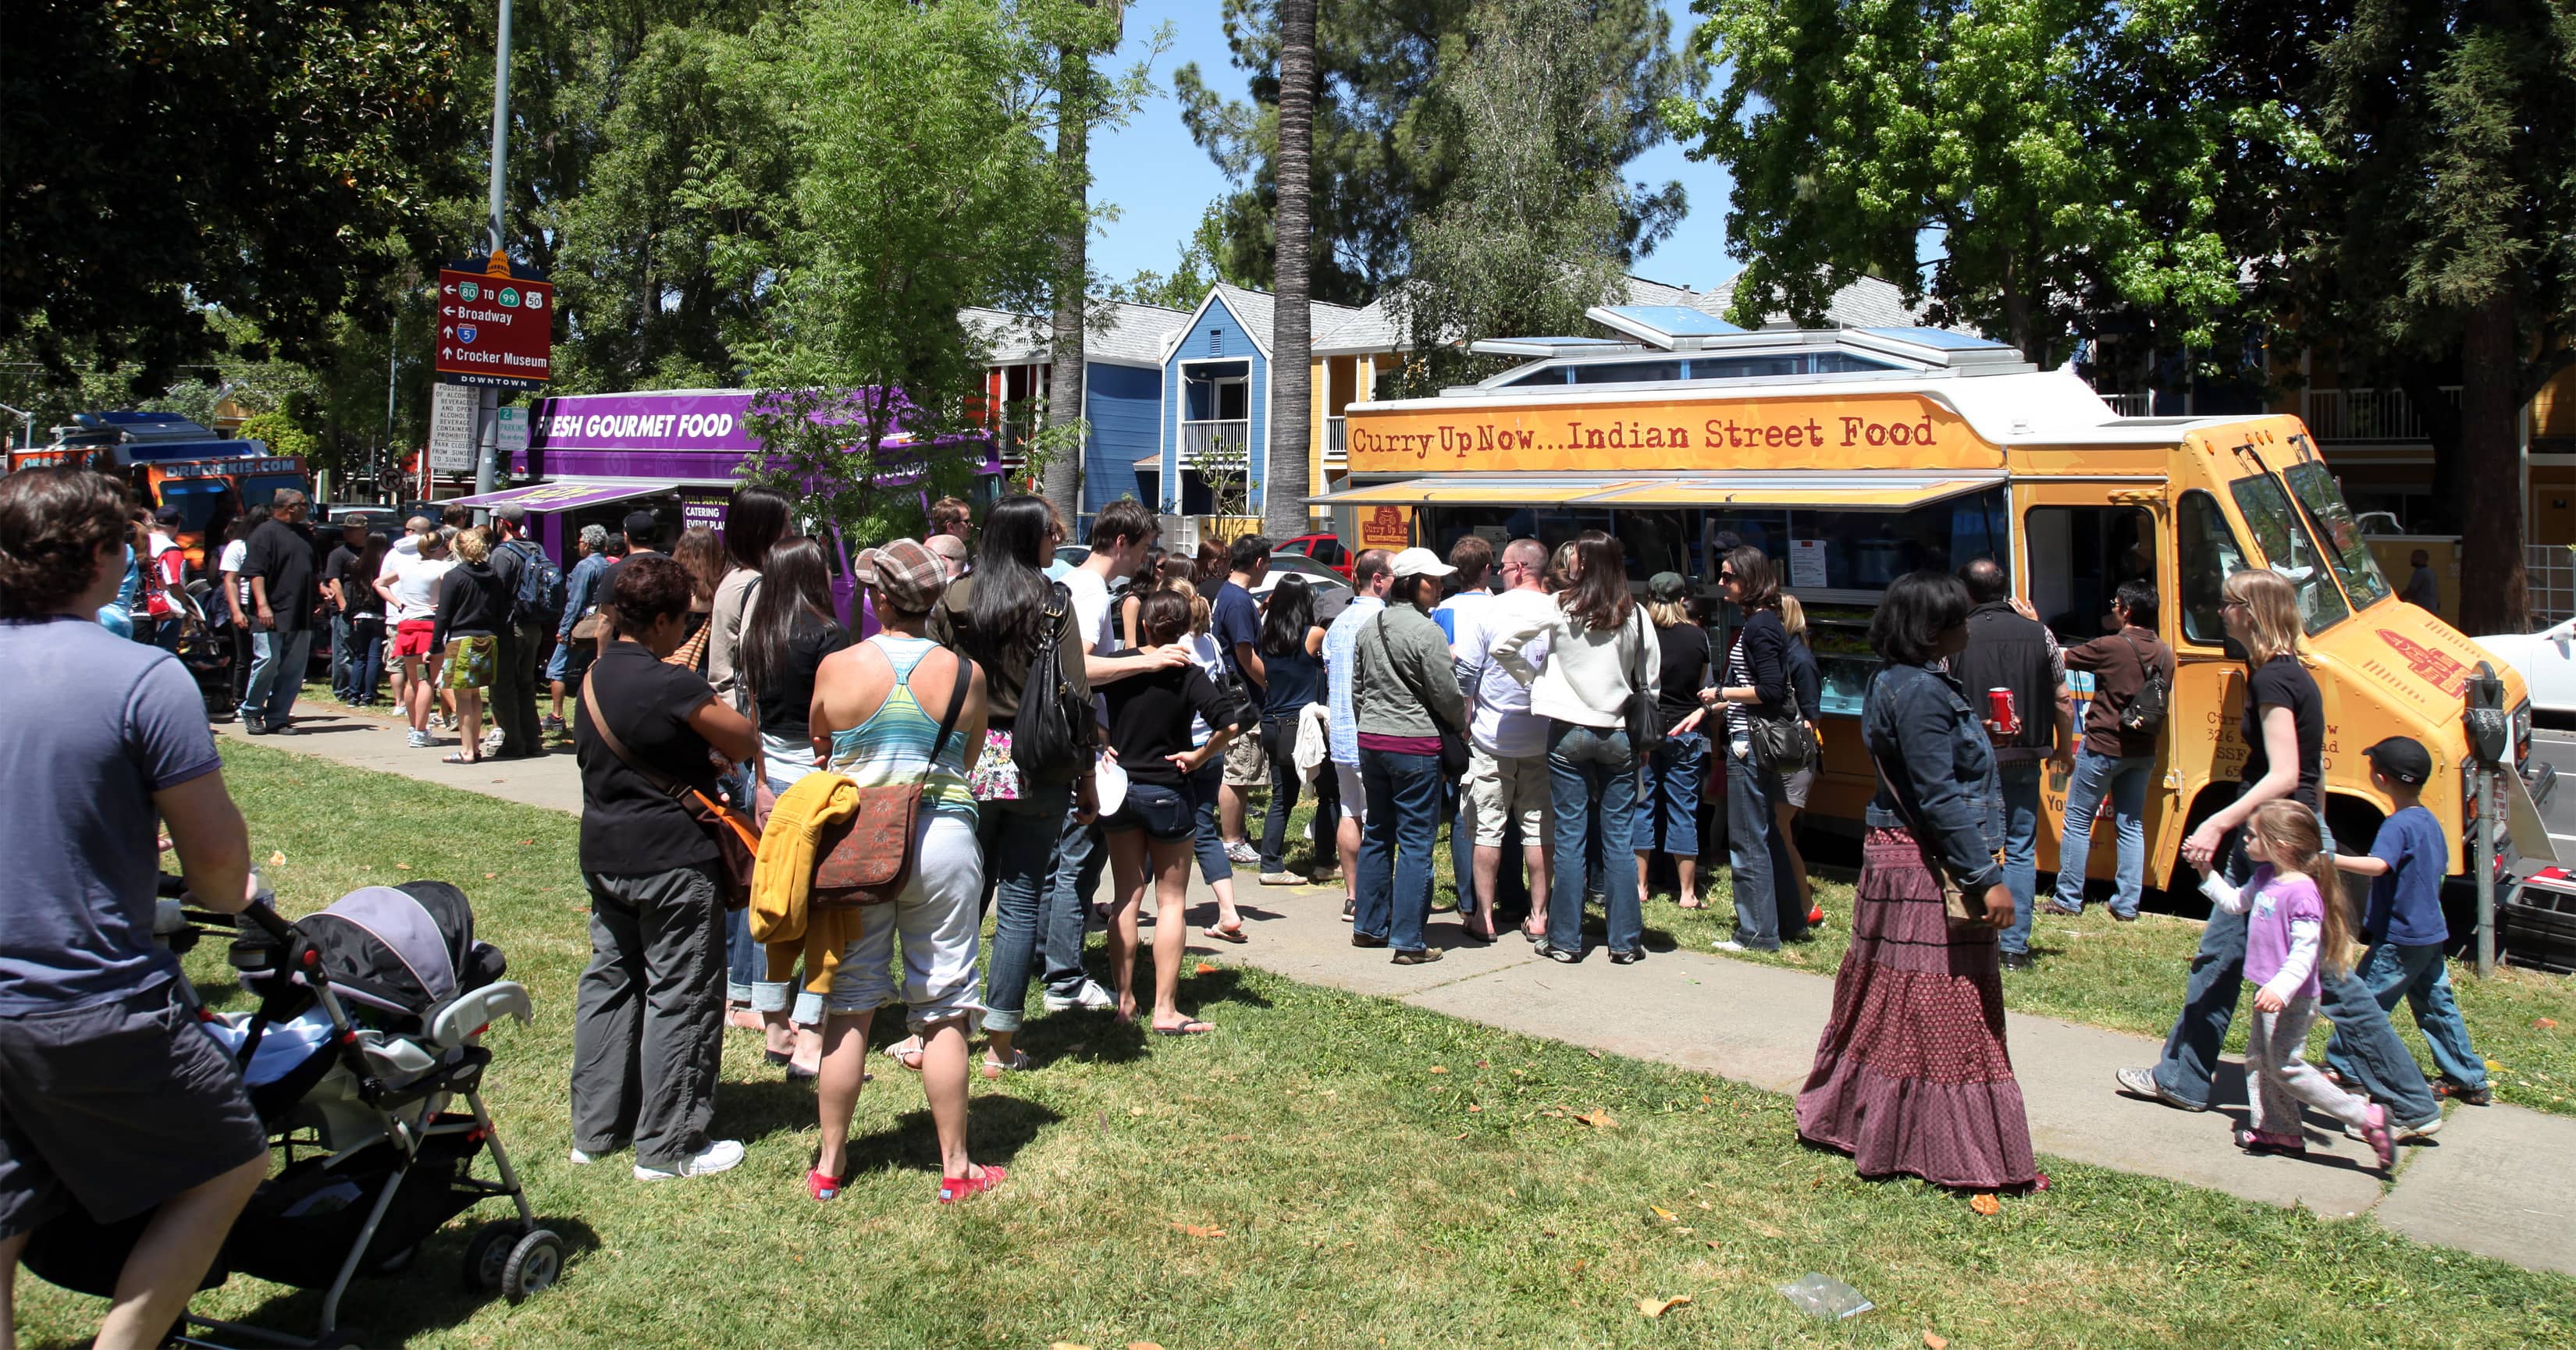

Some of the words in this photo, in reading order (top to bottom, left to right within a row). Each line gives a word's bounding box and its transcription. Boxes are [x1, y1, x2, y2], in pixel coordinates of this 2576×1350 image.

[462, 288, 475, 298] 80
[483, 289, 494, 300] TO
[503, 293, 515, 304] 99
[528, 297, 540, 307] 50
[457, 306, 513, 326] Broadway
[464, 330, 471, 339] 5
[456, 347, 501, 364] Crocker
[503, 352, 547, 368] Museum
[461, 375, 527, 387] DOWNTOWN
[503, 410, 510, 419] 2
[534, 415, 584, 438] FRESH
[585, 414, 676, 438] GOURMET
[678, 414, 733, 438] FOOD
[1352, 427, 1436, 460] Curry
[1438, 426, 1473, 458] Up
[1705, 417, 1824, 449] Street
[1838, 414, 1937, 447] Food
[685, 496, 700, 505] FULL
[702, 496, 730, 506] SERVICE
[685, 506, 720, 518] CATERING
[1398, 525, 1408, 535] No
[2207, 712, 2237, 726] Cur
[2207, 728, 2234, 742] 326
